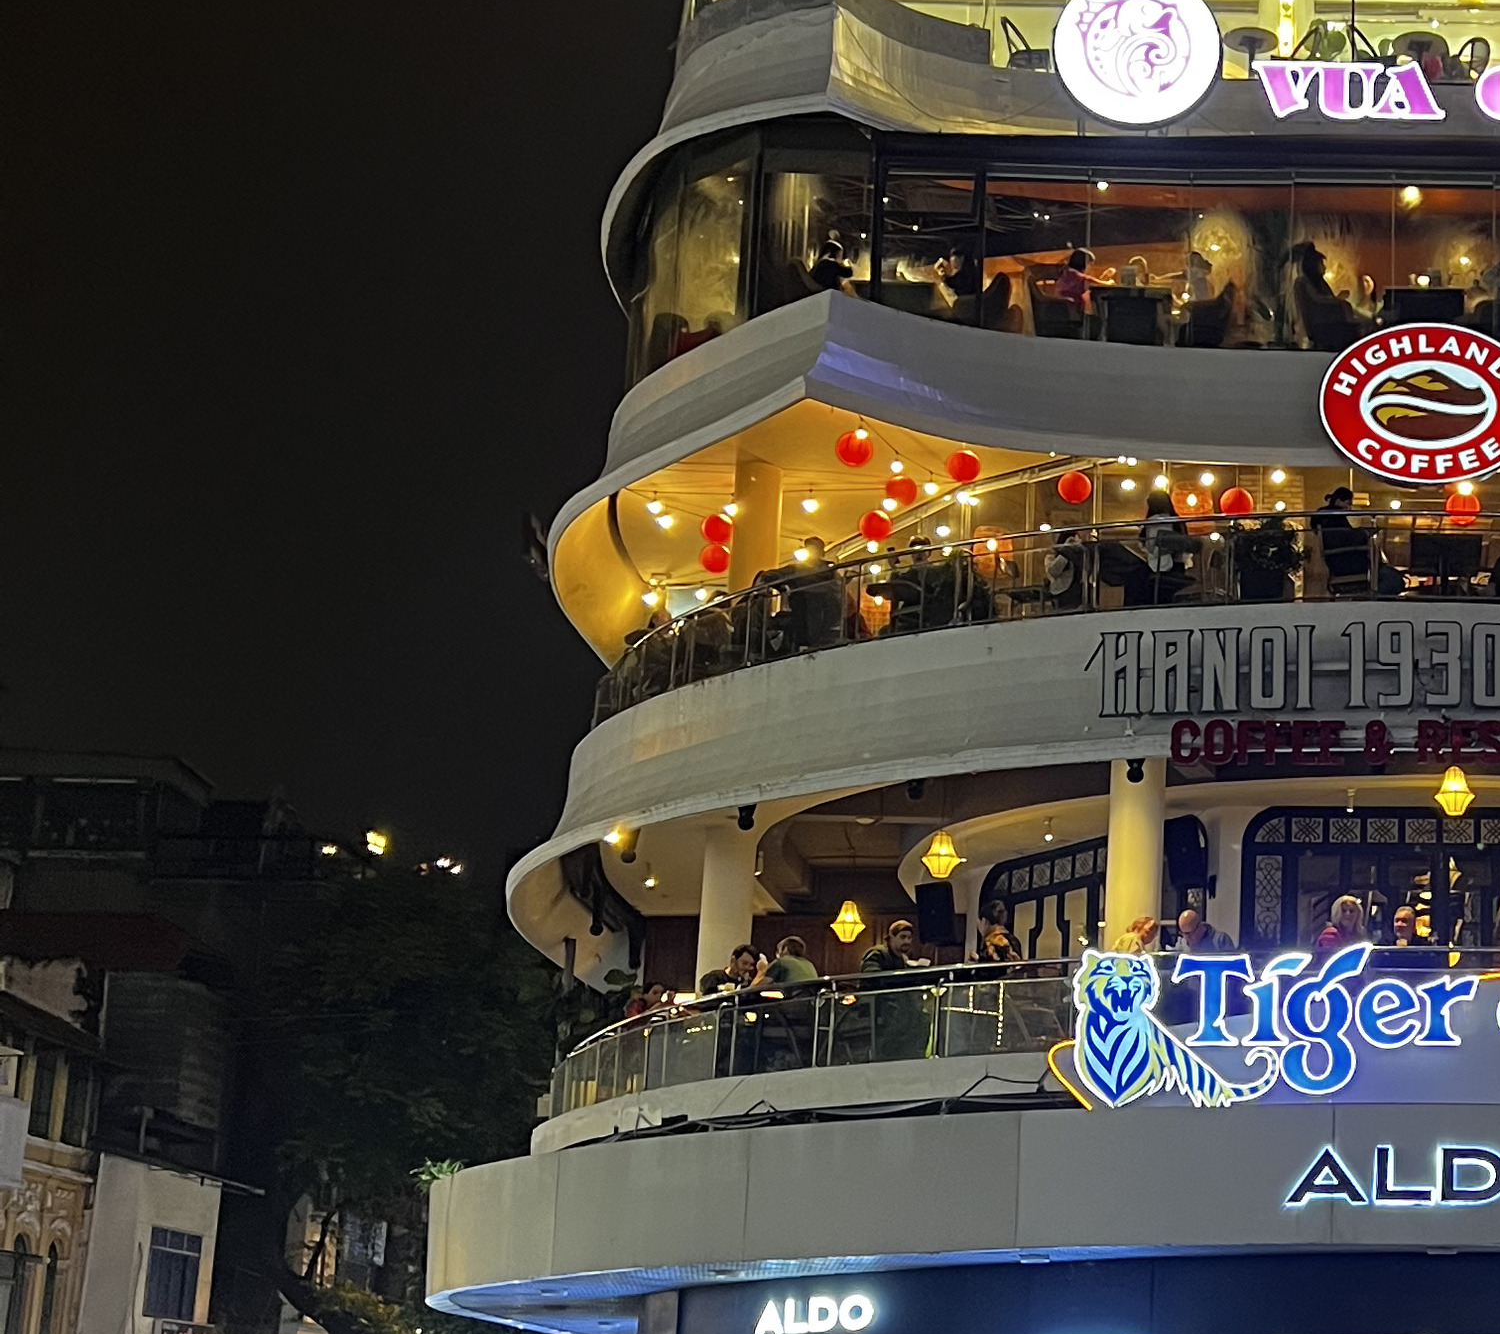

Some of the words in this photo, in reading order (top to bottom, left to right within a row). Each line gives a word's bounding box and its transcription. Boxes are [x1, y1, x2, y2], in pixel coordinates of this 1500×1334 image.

[1252, 59, 1446, 121] VUA
[1098, 623, 1316, 718] HANOI
[1169, 719, 1346, 768] COFFEE
[1362, 720, 1396, 766] &
[1171, 942, 1484, 1096] Tiger
